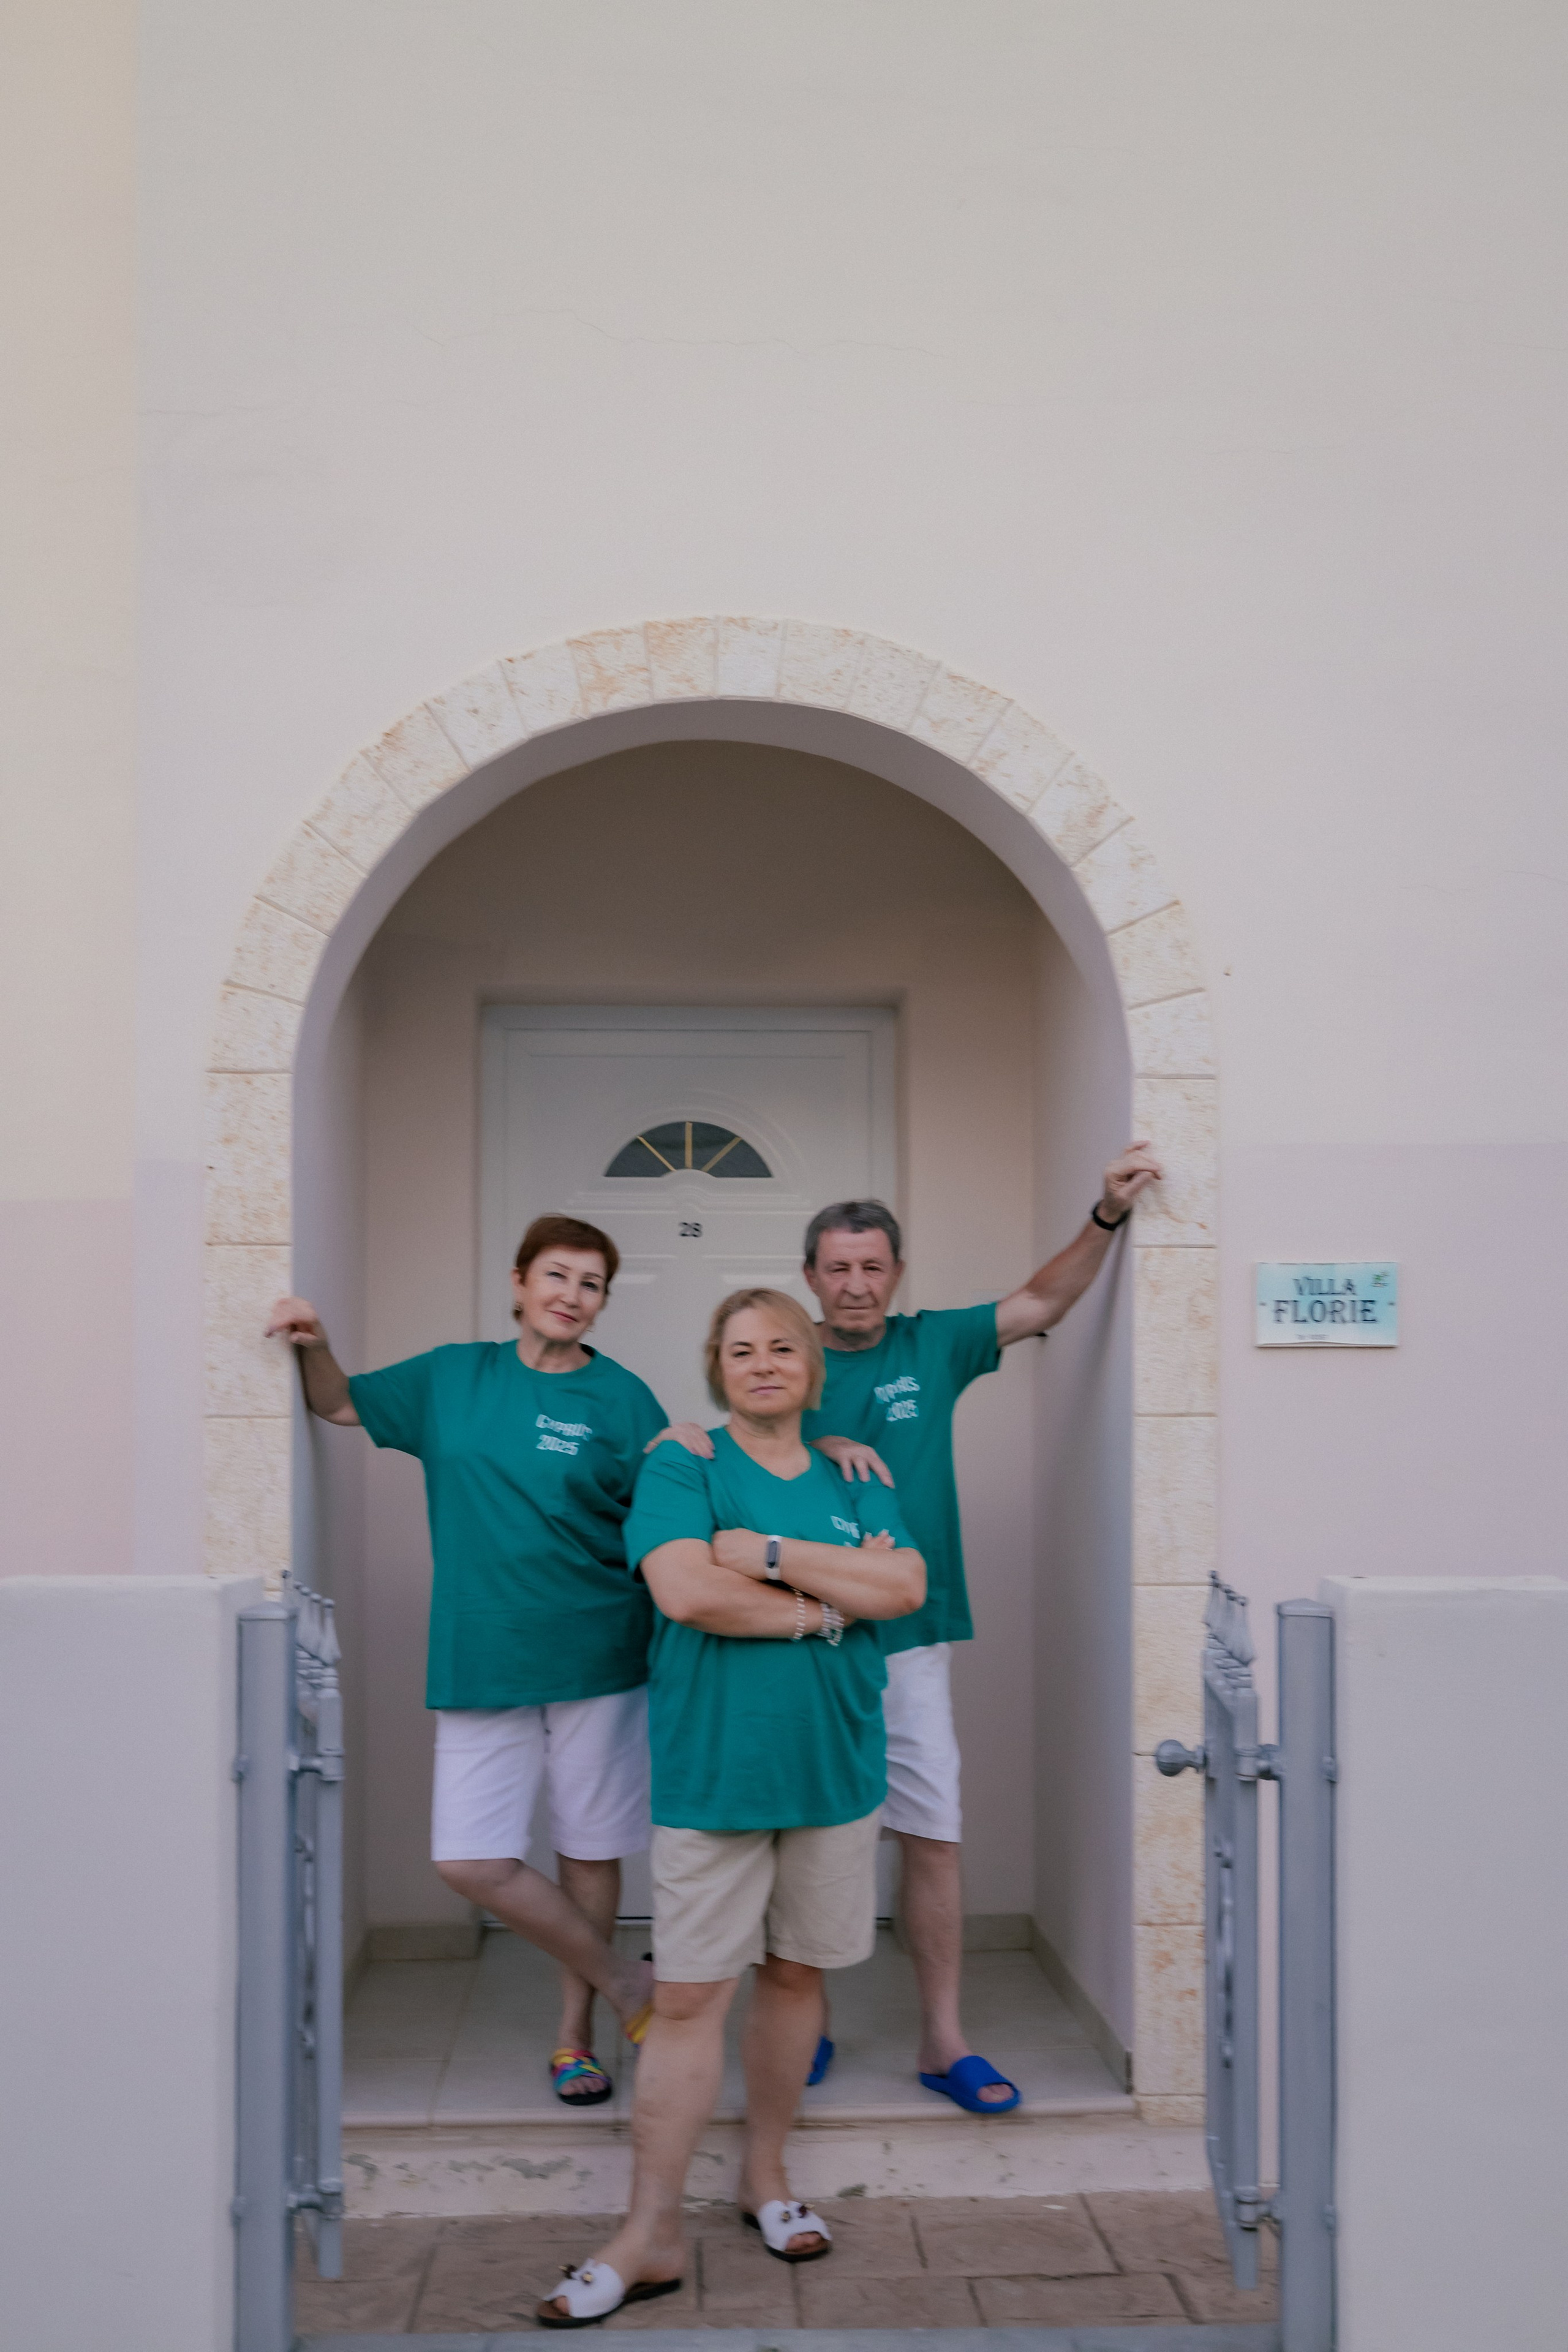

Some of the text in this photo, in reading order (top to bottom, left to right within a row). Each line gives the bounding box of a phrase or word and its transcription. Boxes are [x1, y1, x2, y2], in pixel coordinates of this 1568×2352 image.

[678, 1222, 703, 1237] 28
[1292, 1276, 1357, 1296] VILLA
[1272, 1300, 1379, 1324] FLORIE
[535, 1434, 580, 1455] 2025
